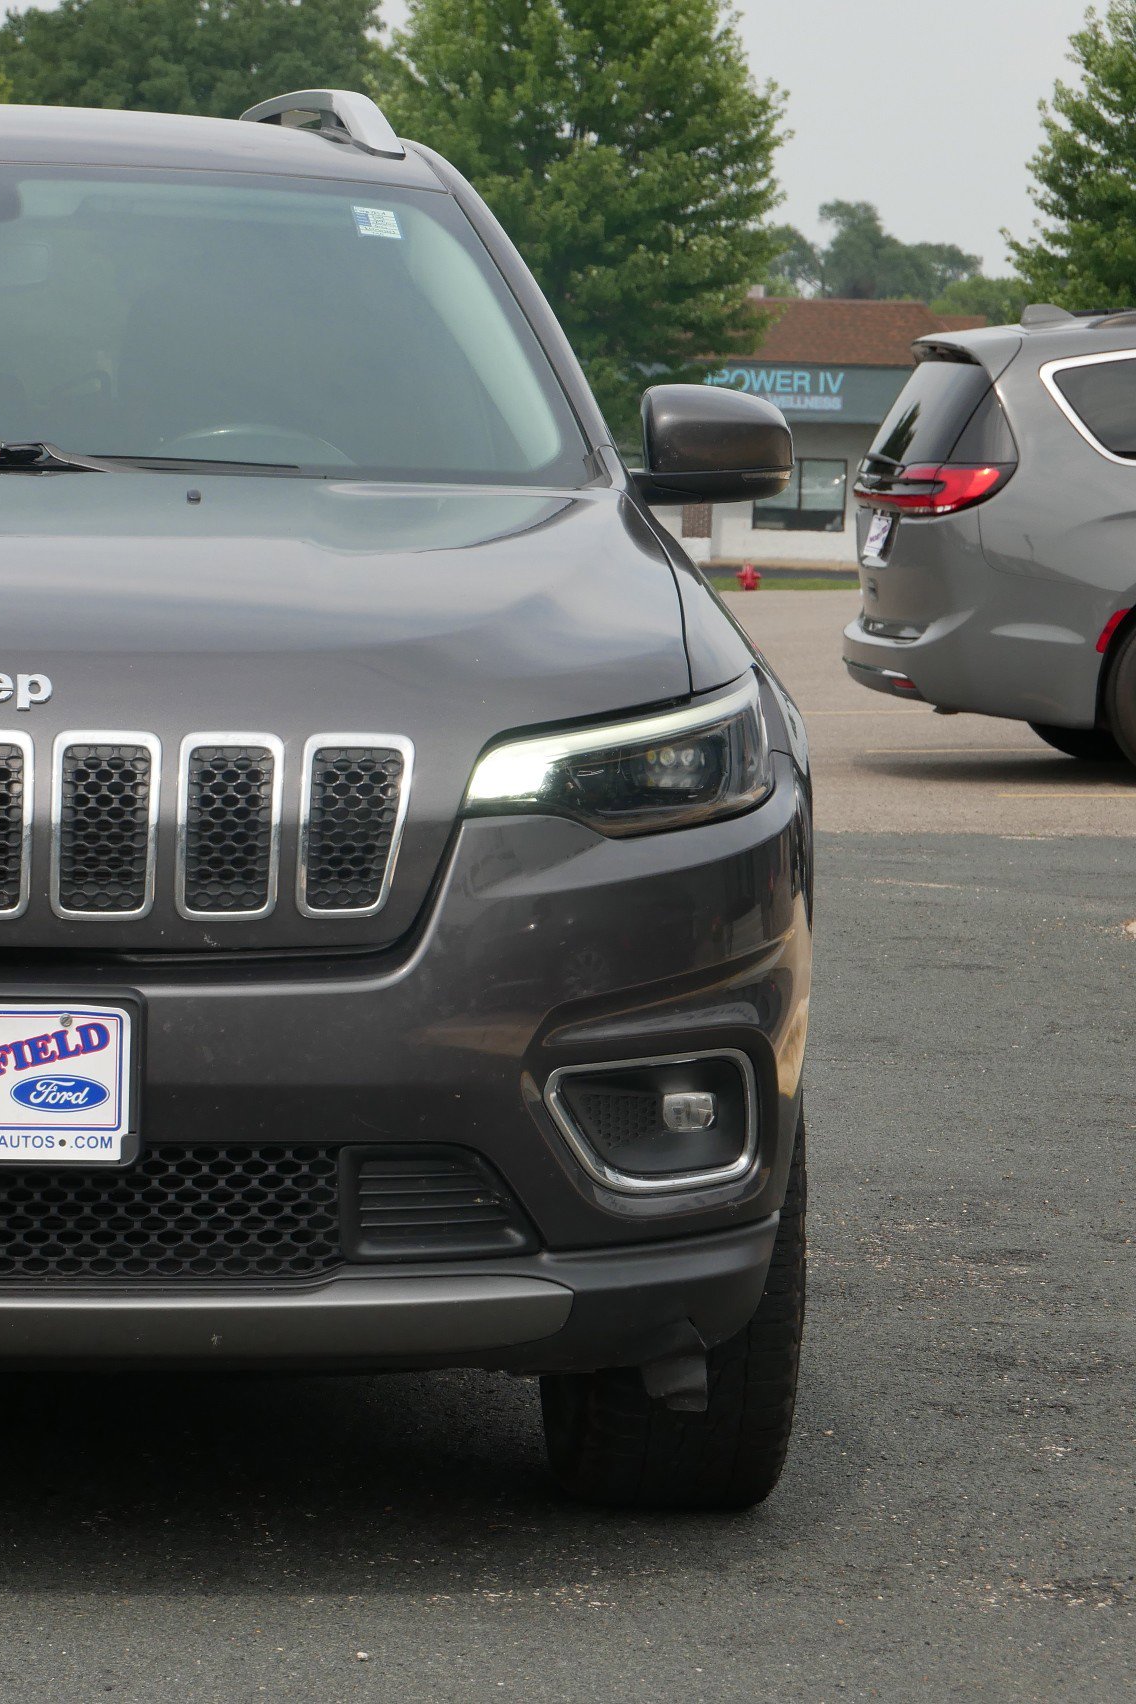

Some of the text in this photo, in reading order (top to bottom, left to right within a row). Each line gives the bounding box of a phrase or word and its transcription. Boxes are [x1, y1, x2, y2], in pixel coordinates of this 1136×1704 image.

[704, 368, 844, 393] POWER IV
[29, 1079, 89, 1105] Ford
